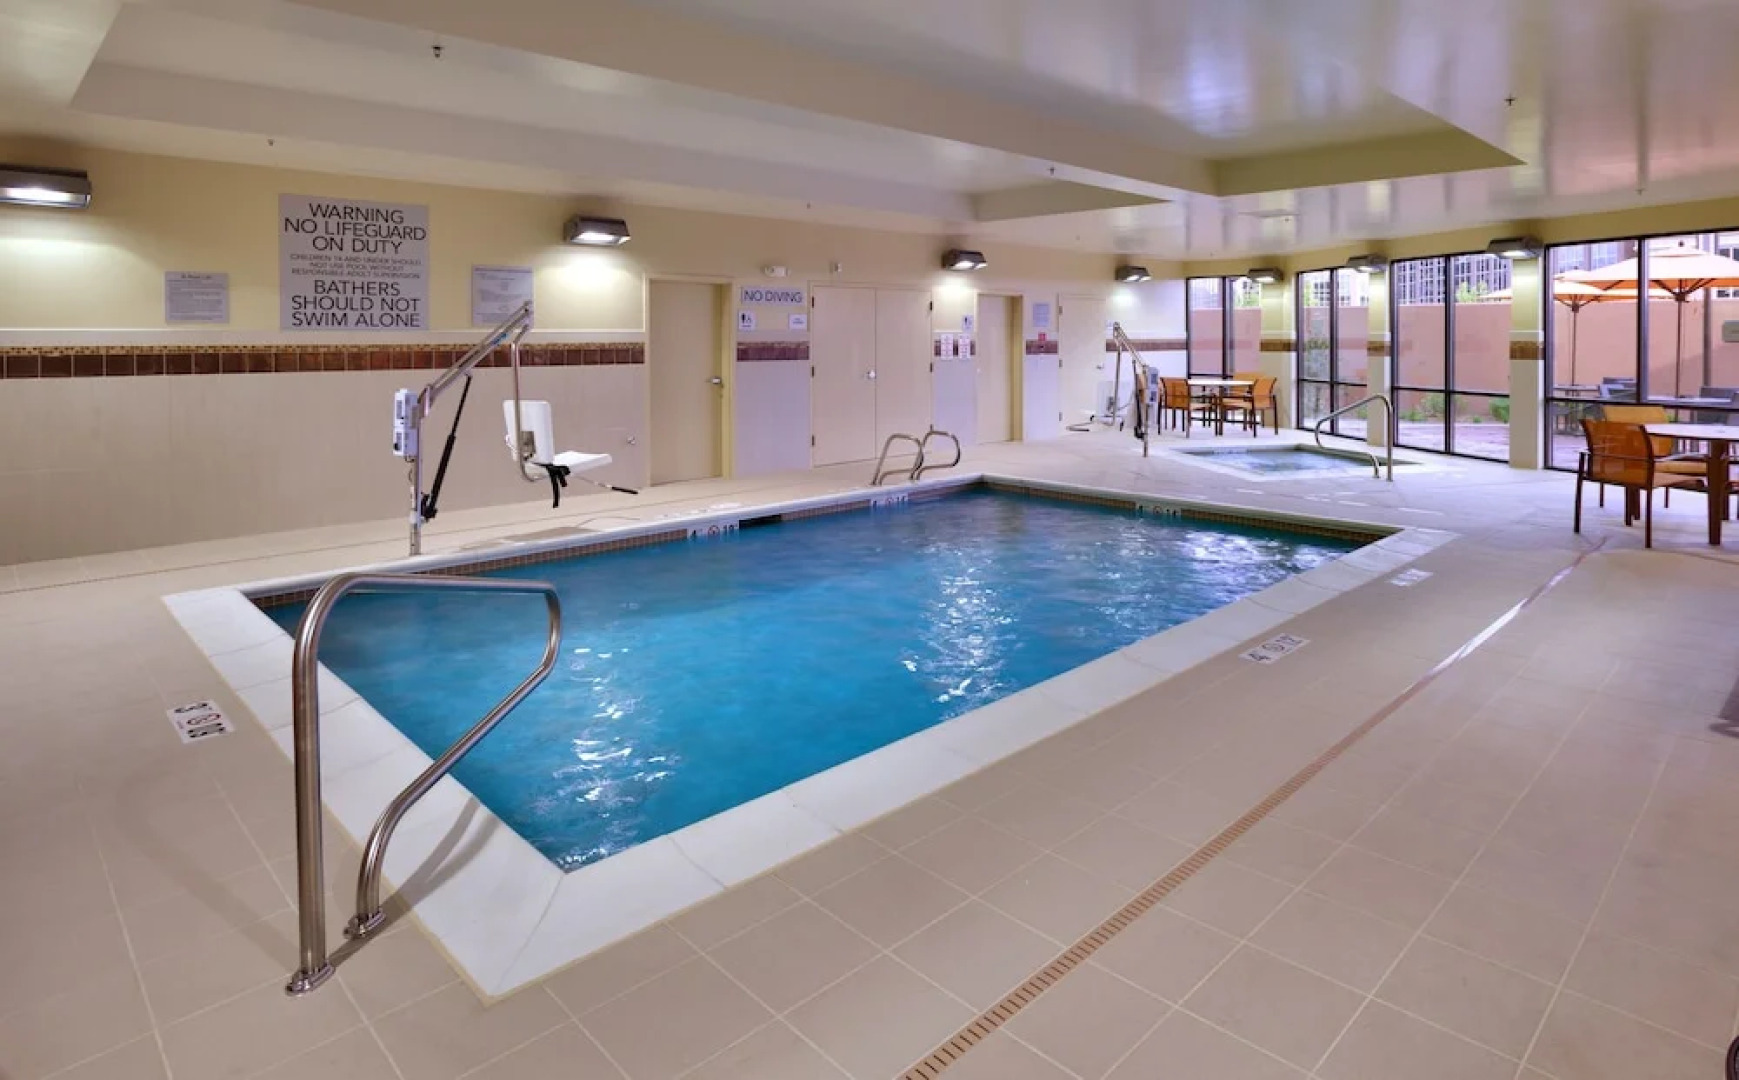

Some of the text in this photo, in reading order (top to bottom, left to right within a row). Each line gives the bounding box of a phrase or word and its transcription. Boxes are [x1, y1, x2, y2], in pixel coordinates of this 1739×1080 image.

[309, 203, 405, 224] WARNING
[284, 218, 427, 241] NO LIFEGUARD
[312, 236, 403, 254] ON DUTY
[330, 262, 344, 270] USE
[346, 263, 366, 271] POOL
[370, 264, 404, 272] WITHOUT
[344, 255, 361, 263] AND
[364, 256, 389, 264] UNDER
[391, 257, 422, 266] SHOULD
[291, 268, 421, 279] RESPONSIBLE ADULT SUPERVISION
[314, 280, 401, 296] BATHERS
[291, 295, 421, 312] SHOULD NOT
[744, 290, 802, 303] NO DIVING
[291, 311, 421, 327] SWIM ALONE
